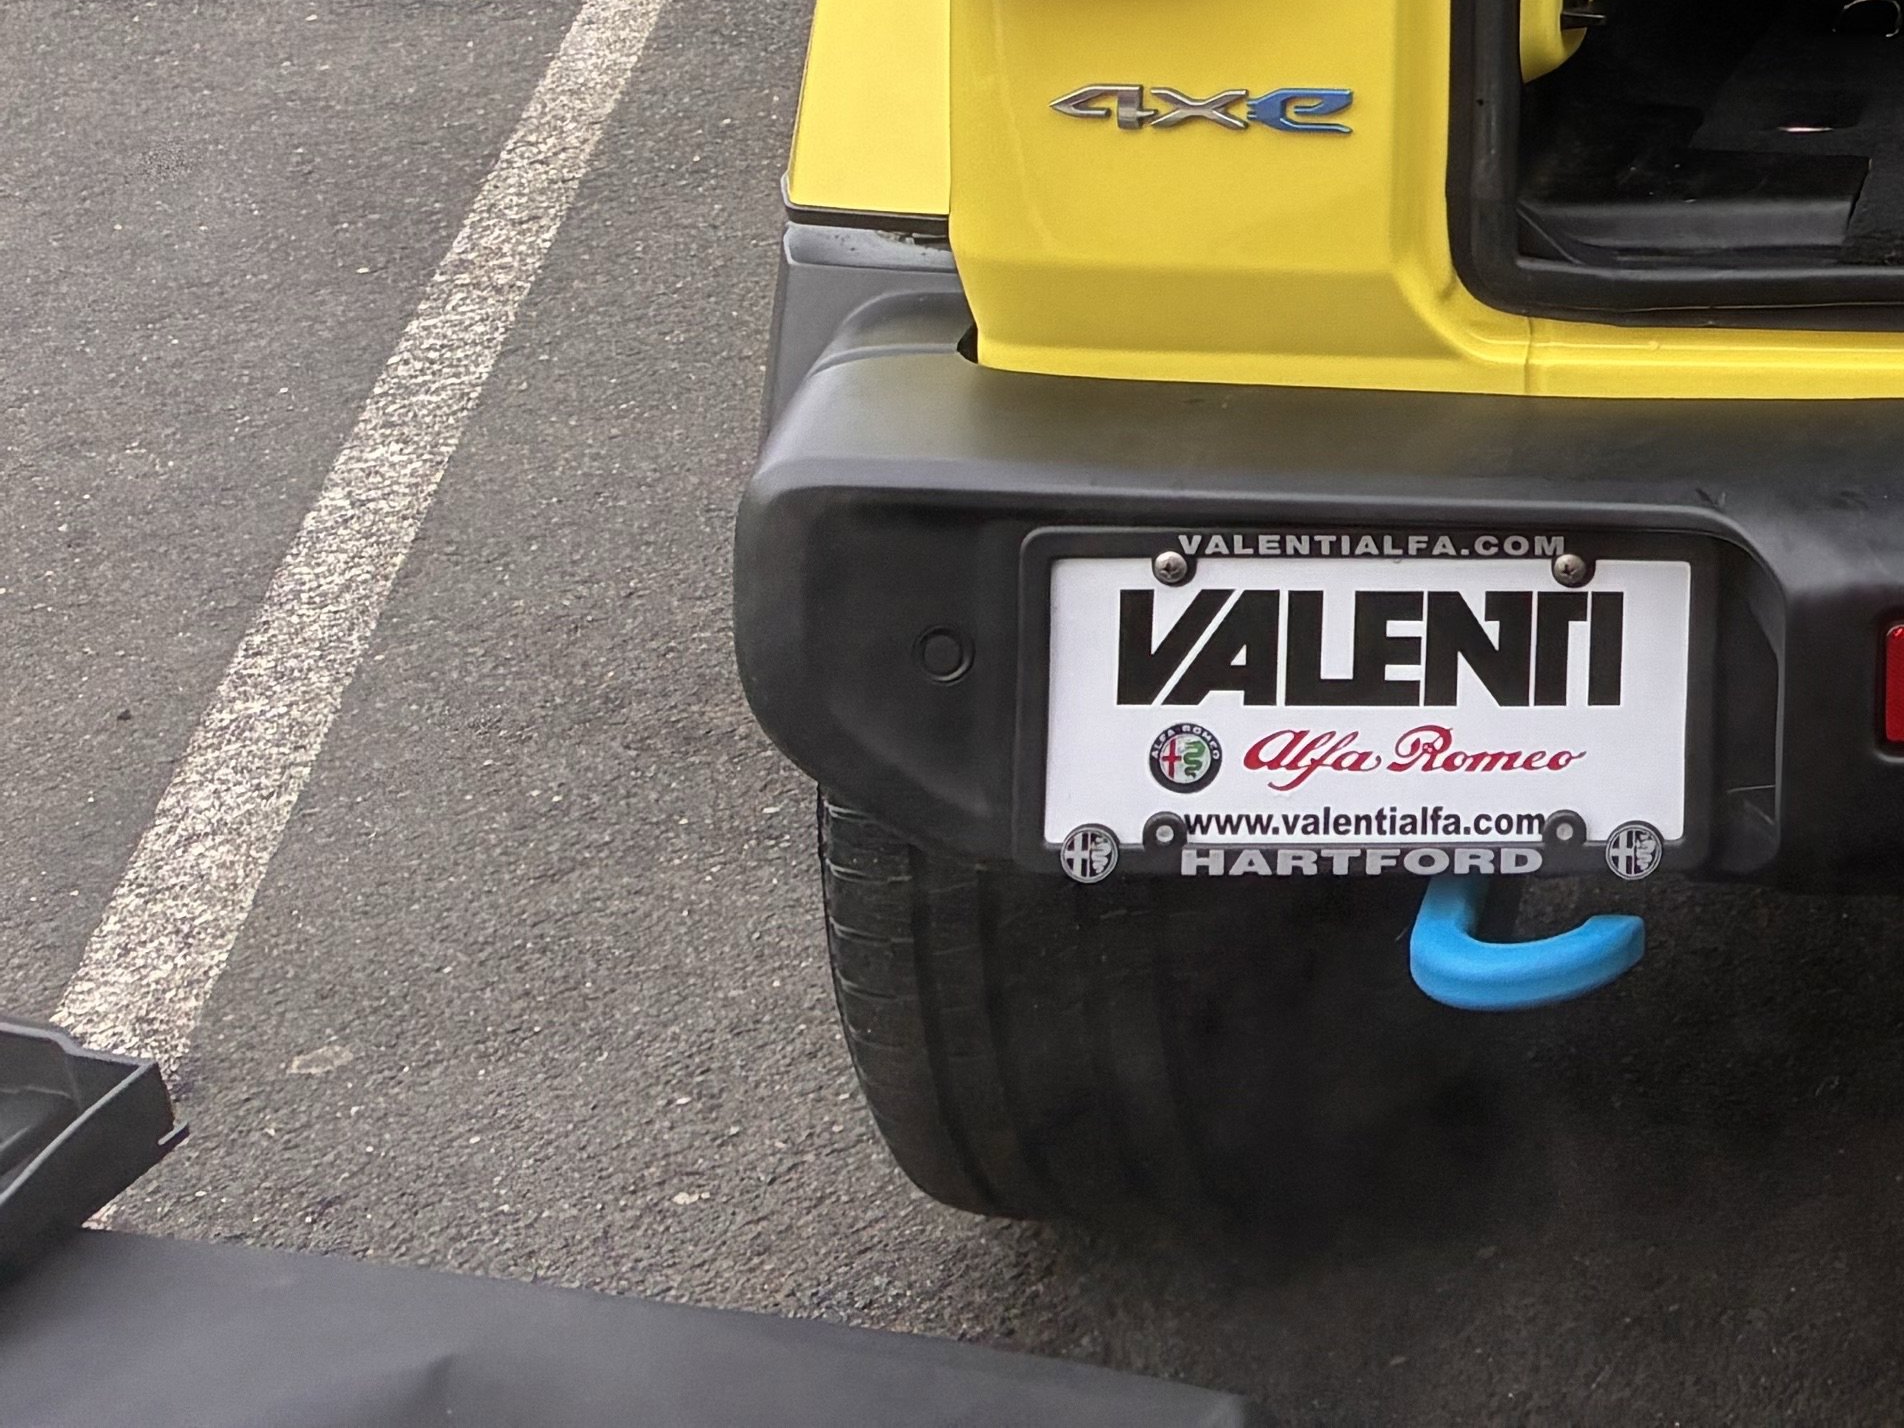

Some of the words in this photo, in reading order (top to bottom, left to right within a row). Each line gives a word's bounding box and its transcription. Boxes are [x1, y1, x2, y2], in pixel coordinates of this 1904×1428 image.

[1178, 533, 1565, 557] VALENTIALFA.COM
[1116, 588, 1625, 707] VALENTI
[1243, 729, 1382, 792] Alfa
[1386, 723, 1587, 773] Romeo
[1184, 805, 1547, 837] www.valentialfa.com
[1180, 846, 1544, 877] HARTFORD
